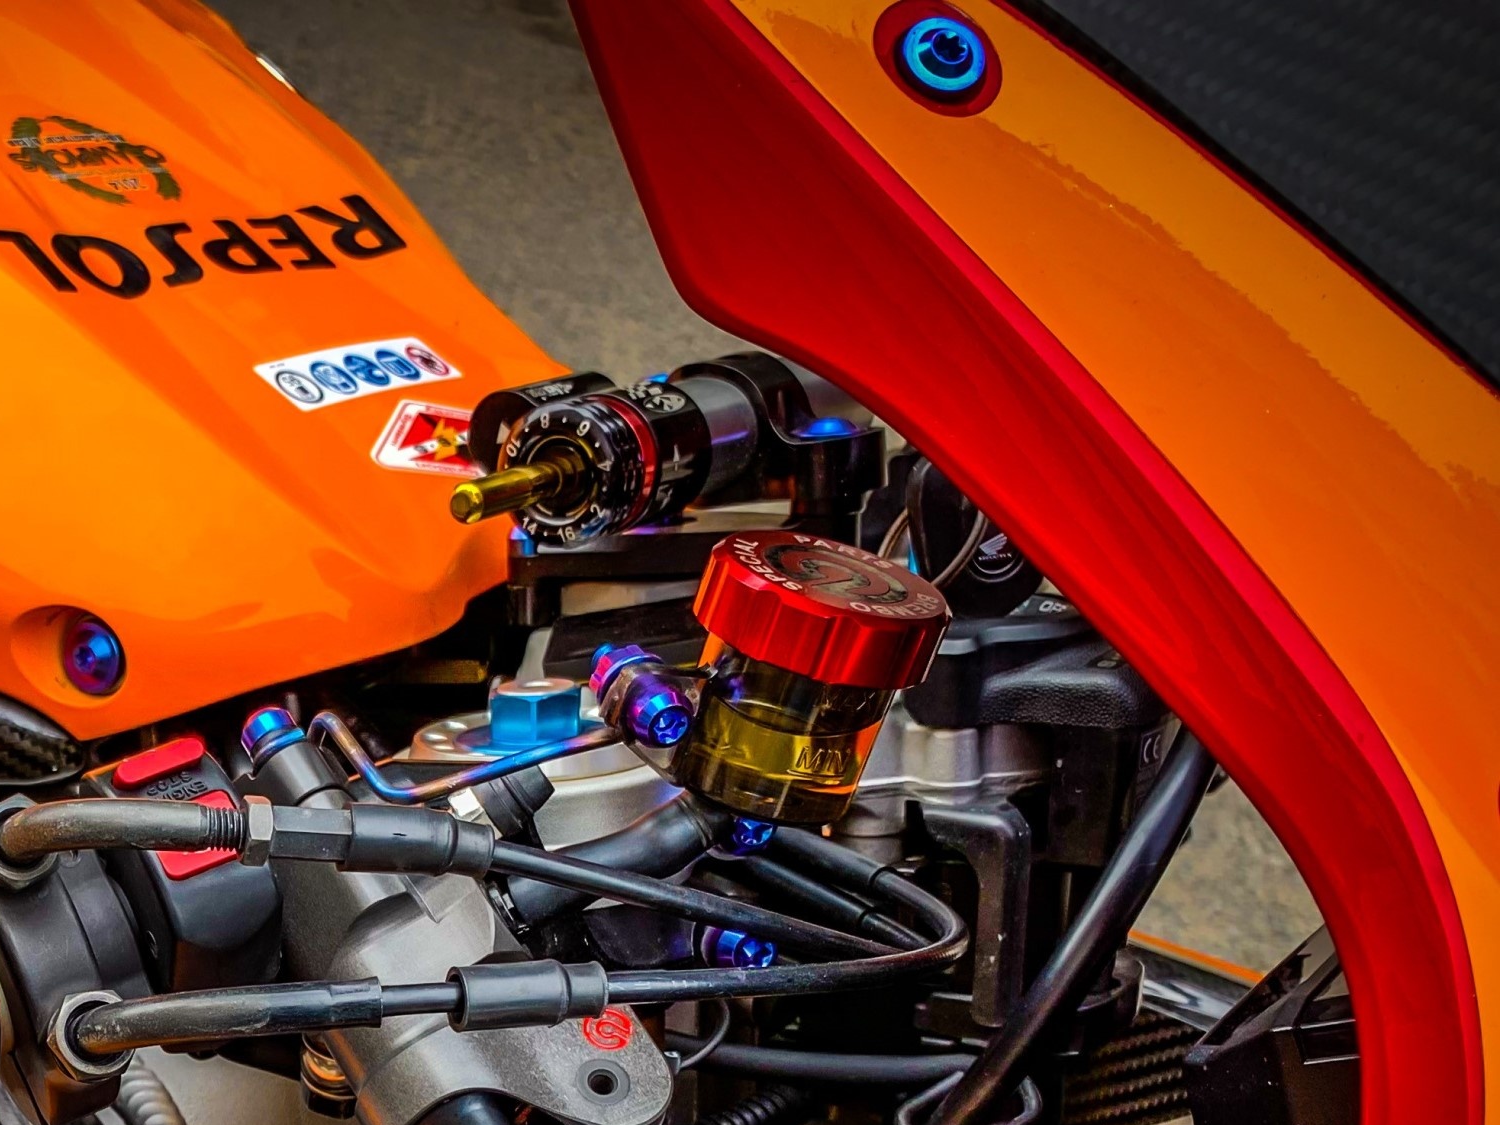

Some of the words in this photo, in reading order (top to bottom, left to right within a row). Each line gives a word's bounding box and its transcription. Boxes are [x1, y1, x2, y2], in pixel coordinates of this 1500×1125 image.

[539, 412, 550, 429] 8
[522, 516, 538, 536] 14
[556, 526, 576, 543] 16
[793, 534, 894, 569] PARTS
[733, 537, 803, 591] SPECIAL
[848, 592, 940, 617] BREMBO
[794, 744, 852, 774] MIN
[161, 780, 209, 801] ENG
